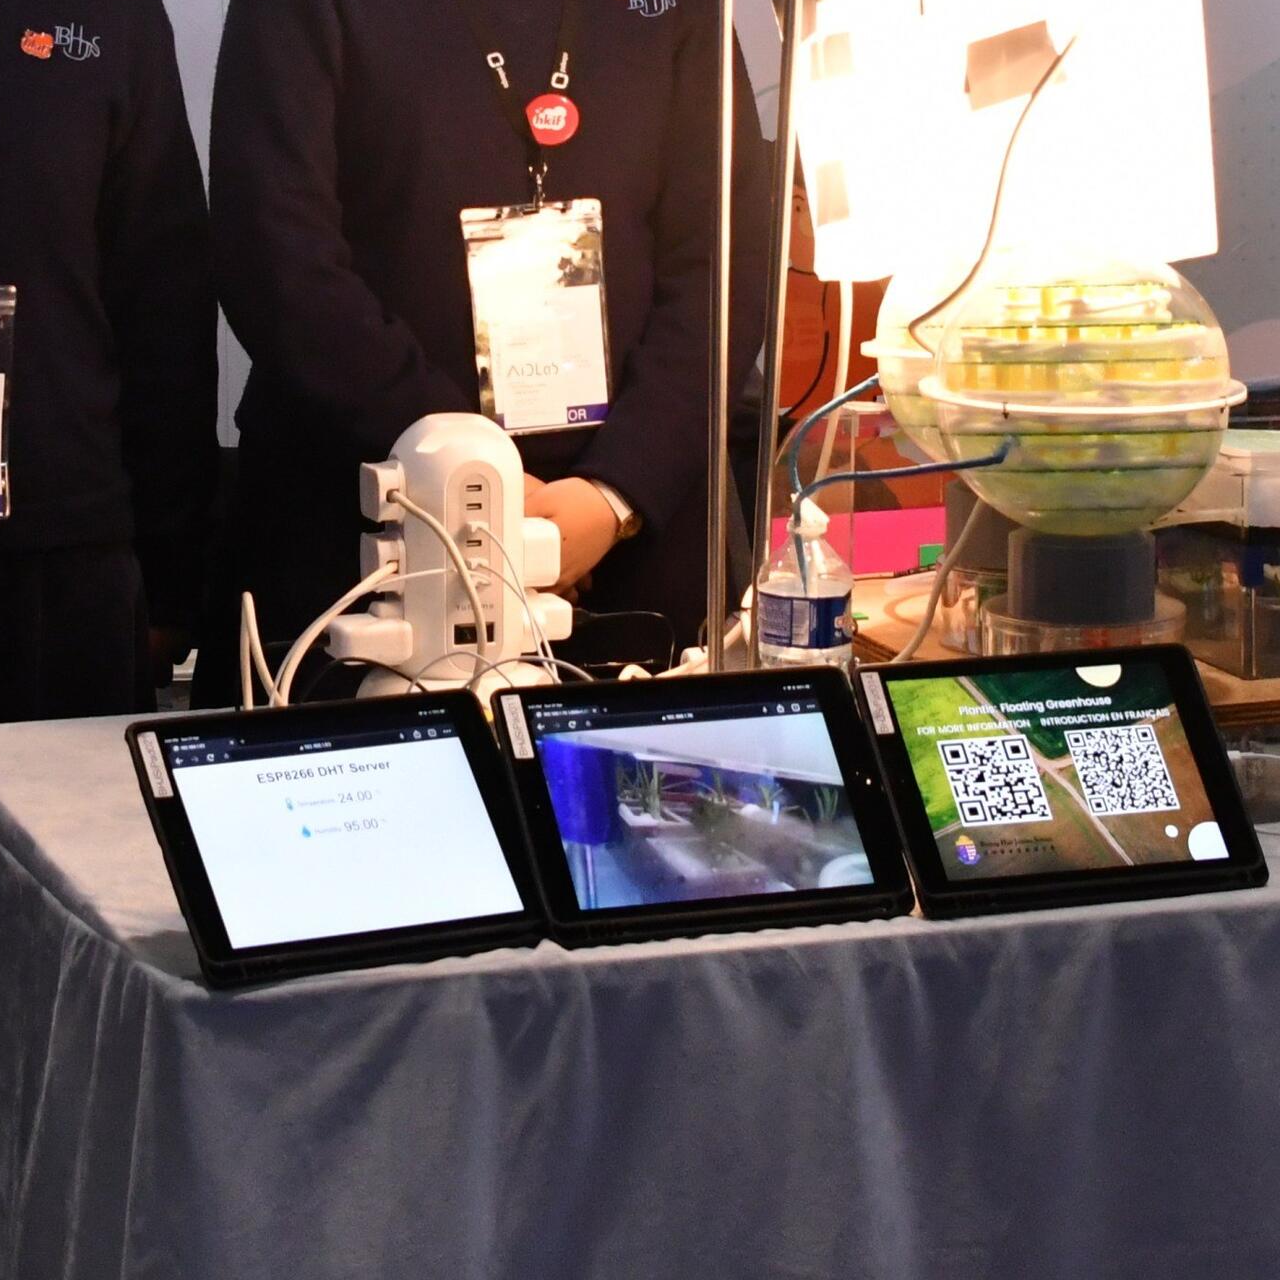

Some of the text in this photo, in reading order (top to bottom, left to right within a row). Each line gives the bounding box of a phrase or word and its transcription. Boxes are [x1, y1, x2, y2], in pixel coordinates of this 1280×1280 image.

[1000, 701, 1044, 714] Floating
[1046, 696, 1112, 710] Greenhouse
[1040, 712, 1110, 726] INTRODUCTION
[1111, 711, 1124, 721] EN
[257, 760, 391, 784] ESP8266 DHT Server
[339, 790, 373, 803] 24.00
[344, 818, 379, 832] 95.00
